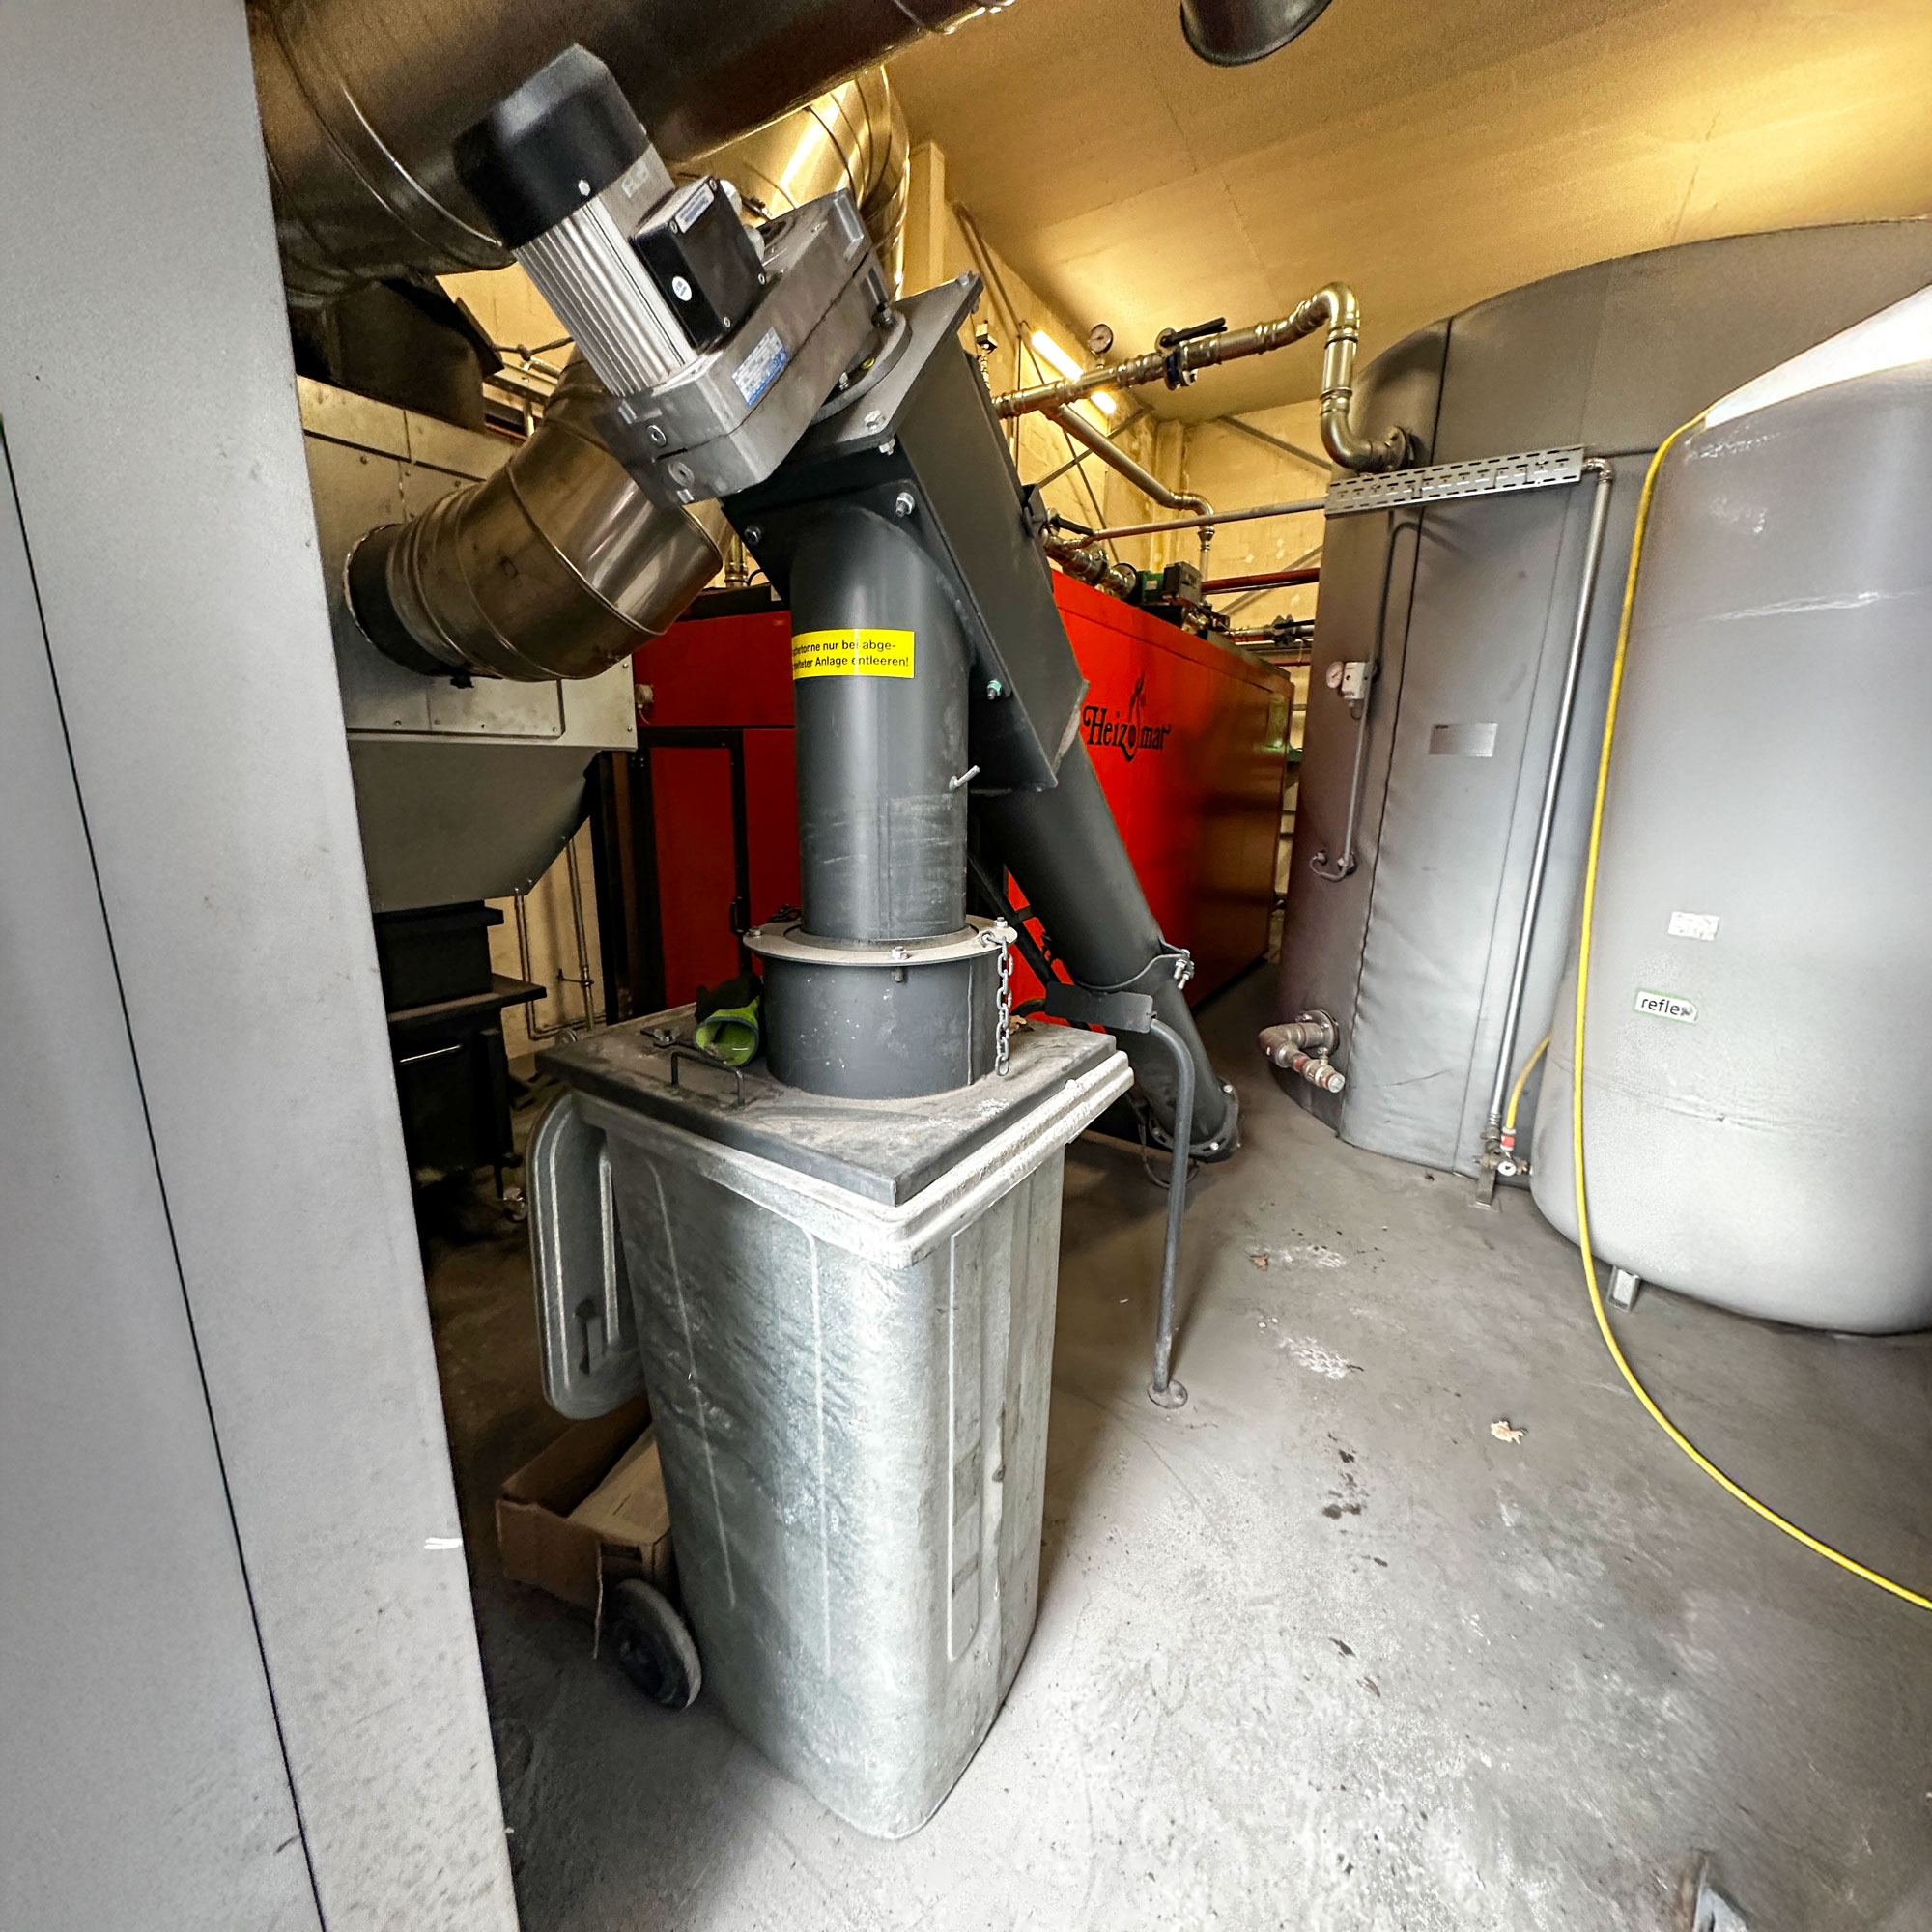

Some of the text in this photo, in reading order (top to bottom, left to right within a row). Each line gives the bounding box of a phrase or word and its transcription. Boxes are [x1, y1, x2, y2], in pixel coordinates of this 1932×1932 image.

[822, 641, 839, 651] nur
[841, 639, 859, 650] bei
[862, 639, 896, 652] abge-
[814, 656, 848, 668] Anlage
[851, 655, 909, 667] entleeren!
[1083, 705, 1172, 762] Heizomat
